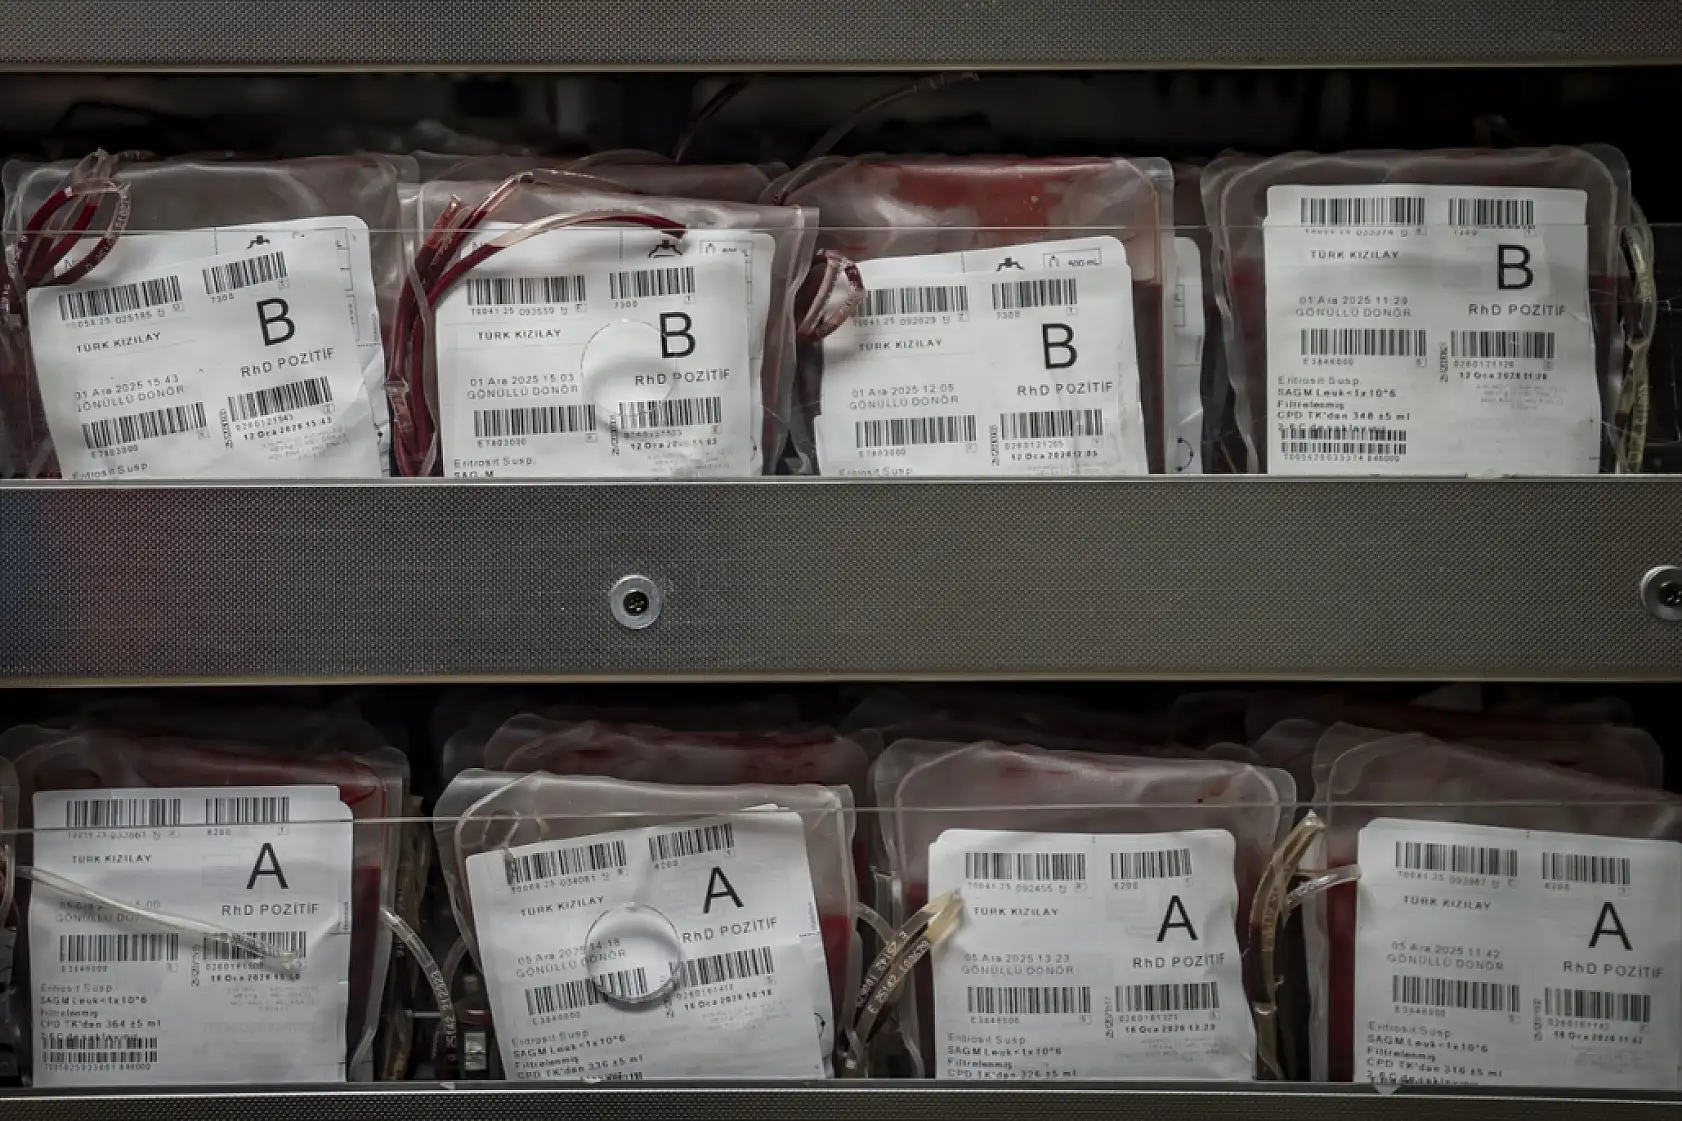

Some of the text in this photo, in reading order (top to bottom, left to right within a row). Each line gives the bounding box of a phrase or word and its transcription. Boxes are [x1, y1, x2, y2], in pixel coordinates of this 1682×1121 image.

[1349, 251, 1400, 259] KIZILAY
[1497, 244, 1534, 291] B
[1341, 296, 1371, 305] 2025
[1468, 304, 1502, 316] RhD
[256, 297, 295, 347] B
[515, 329, 561, 339] KIZILAY
[659, 311, 696, 359] B
[895, 338, 943, 349] KIZILAY
[1041, 323, 1078, 369] B
[240, 360, 272, 378] RhD
[635, 373, 668, 387] RhD
[1017, 384, 1050, 396] RhD
[1277, 411, 1303, 420] CPD
[104, 854, 152, 863] KIZILAY
[246, 842, 290, 890] A
[703, 865, 745, 915] A
[221, 901, 320, 916] RhD POZİTİF
[1011, 907, 1060, 916] KIZILAY
[1156, 895, 1199, 943] A
[1588, 901, 1634, 951] A
[682, 927, 714, 944] RhD
[1005, 954, 1034, 963] 2025
[1132, 957, 1166, 969] RhD
[1563, 960, 1598, 975] RhD
